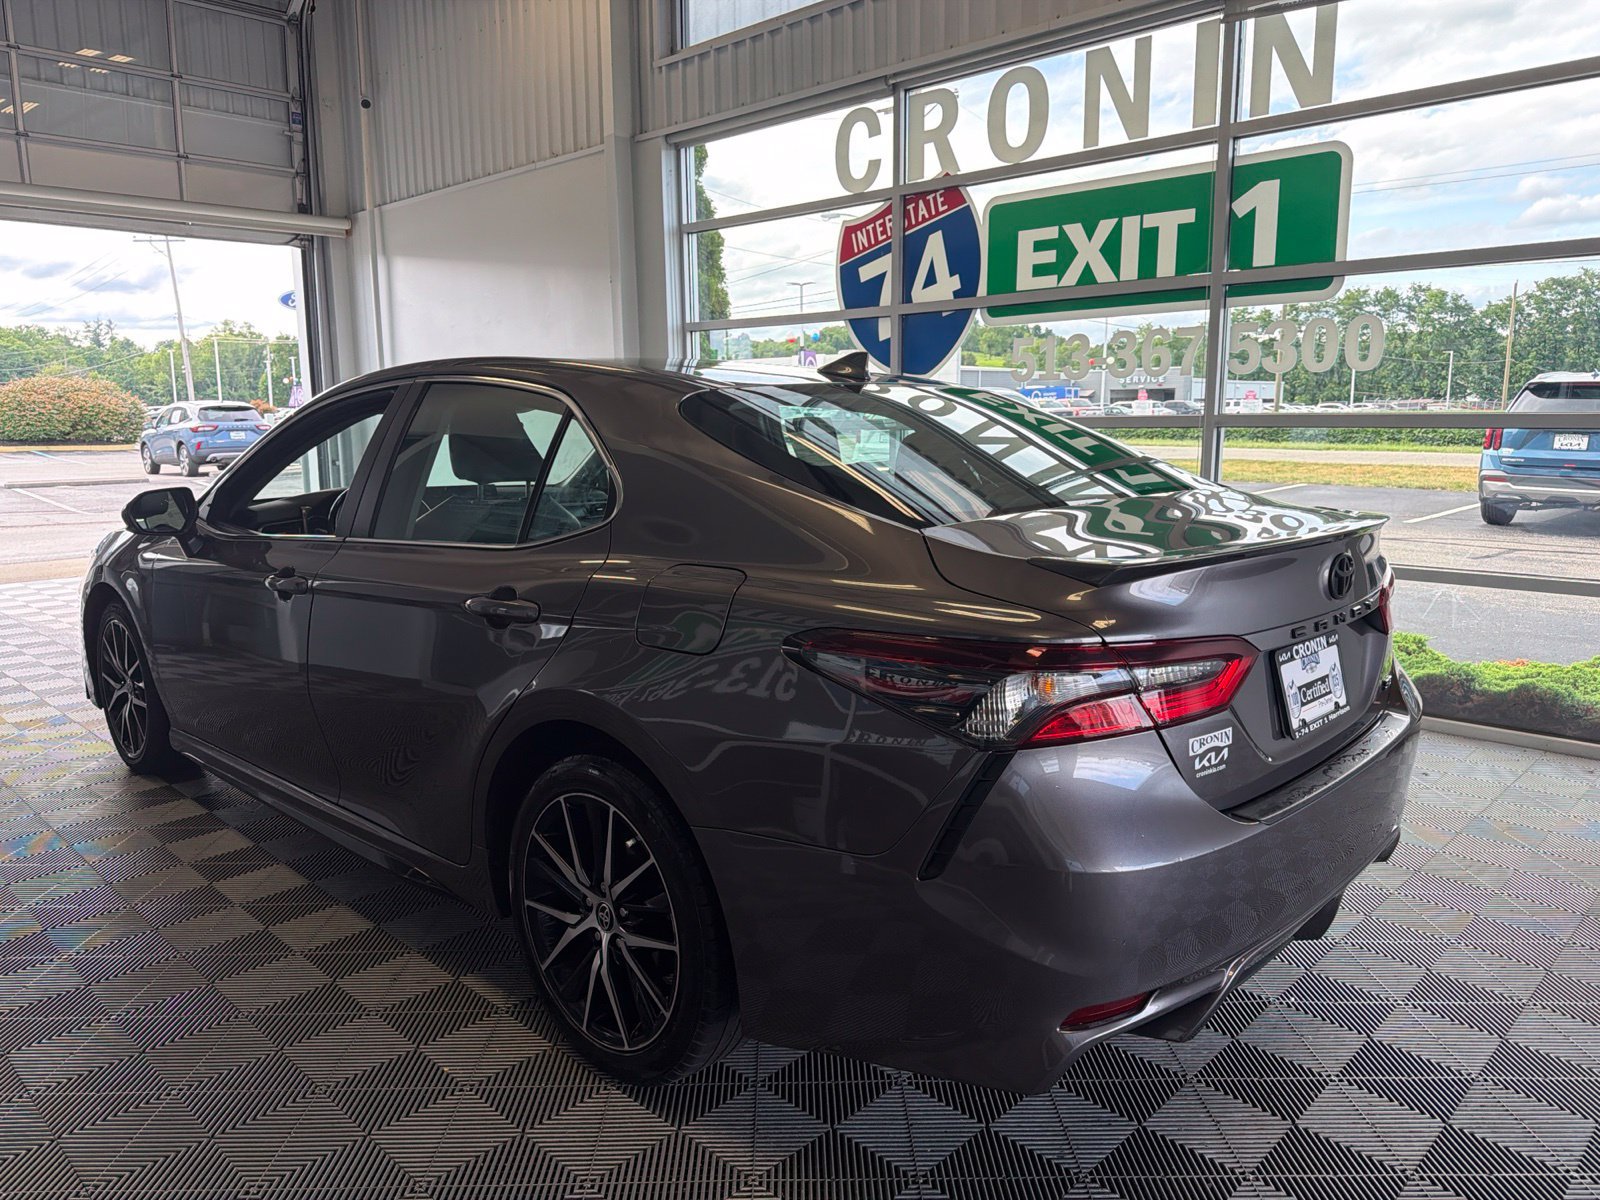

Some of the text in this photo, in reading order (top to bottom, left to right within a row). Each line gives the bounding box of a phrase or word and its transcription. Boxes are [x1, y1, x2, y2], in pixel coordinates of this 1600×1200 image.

[836, 2, 1338, 193] CRONIN
[851, 189, 949, 253] INTERTATE
[1016, 178, 1281, 291] EXIT 1
[858, 230, 962, 342] 74
[1292, 636, 1327, 659] CRONIN
[1300, 678, 1330, 702] Certified
[1309, 718, 1323, 731] EXIT
[1191, 730, 1230, 753] CRONIN
[1196, 764, 1227, 778] croninkia.com
